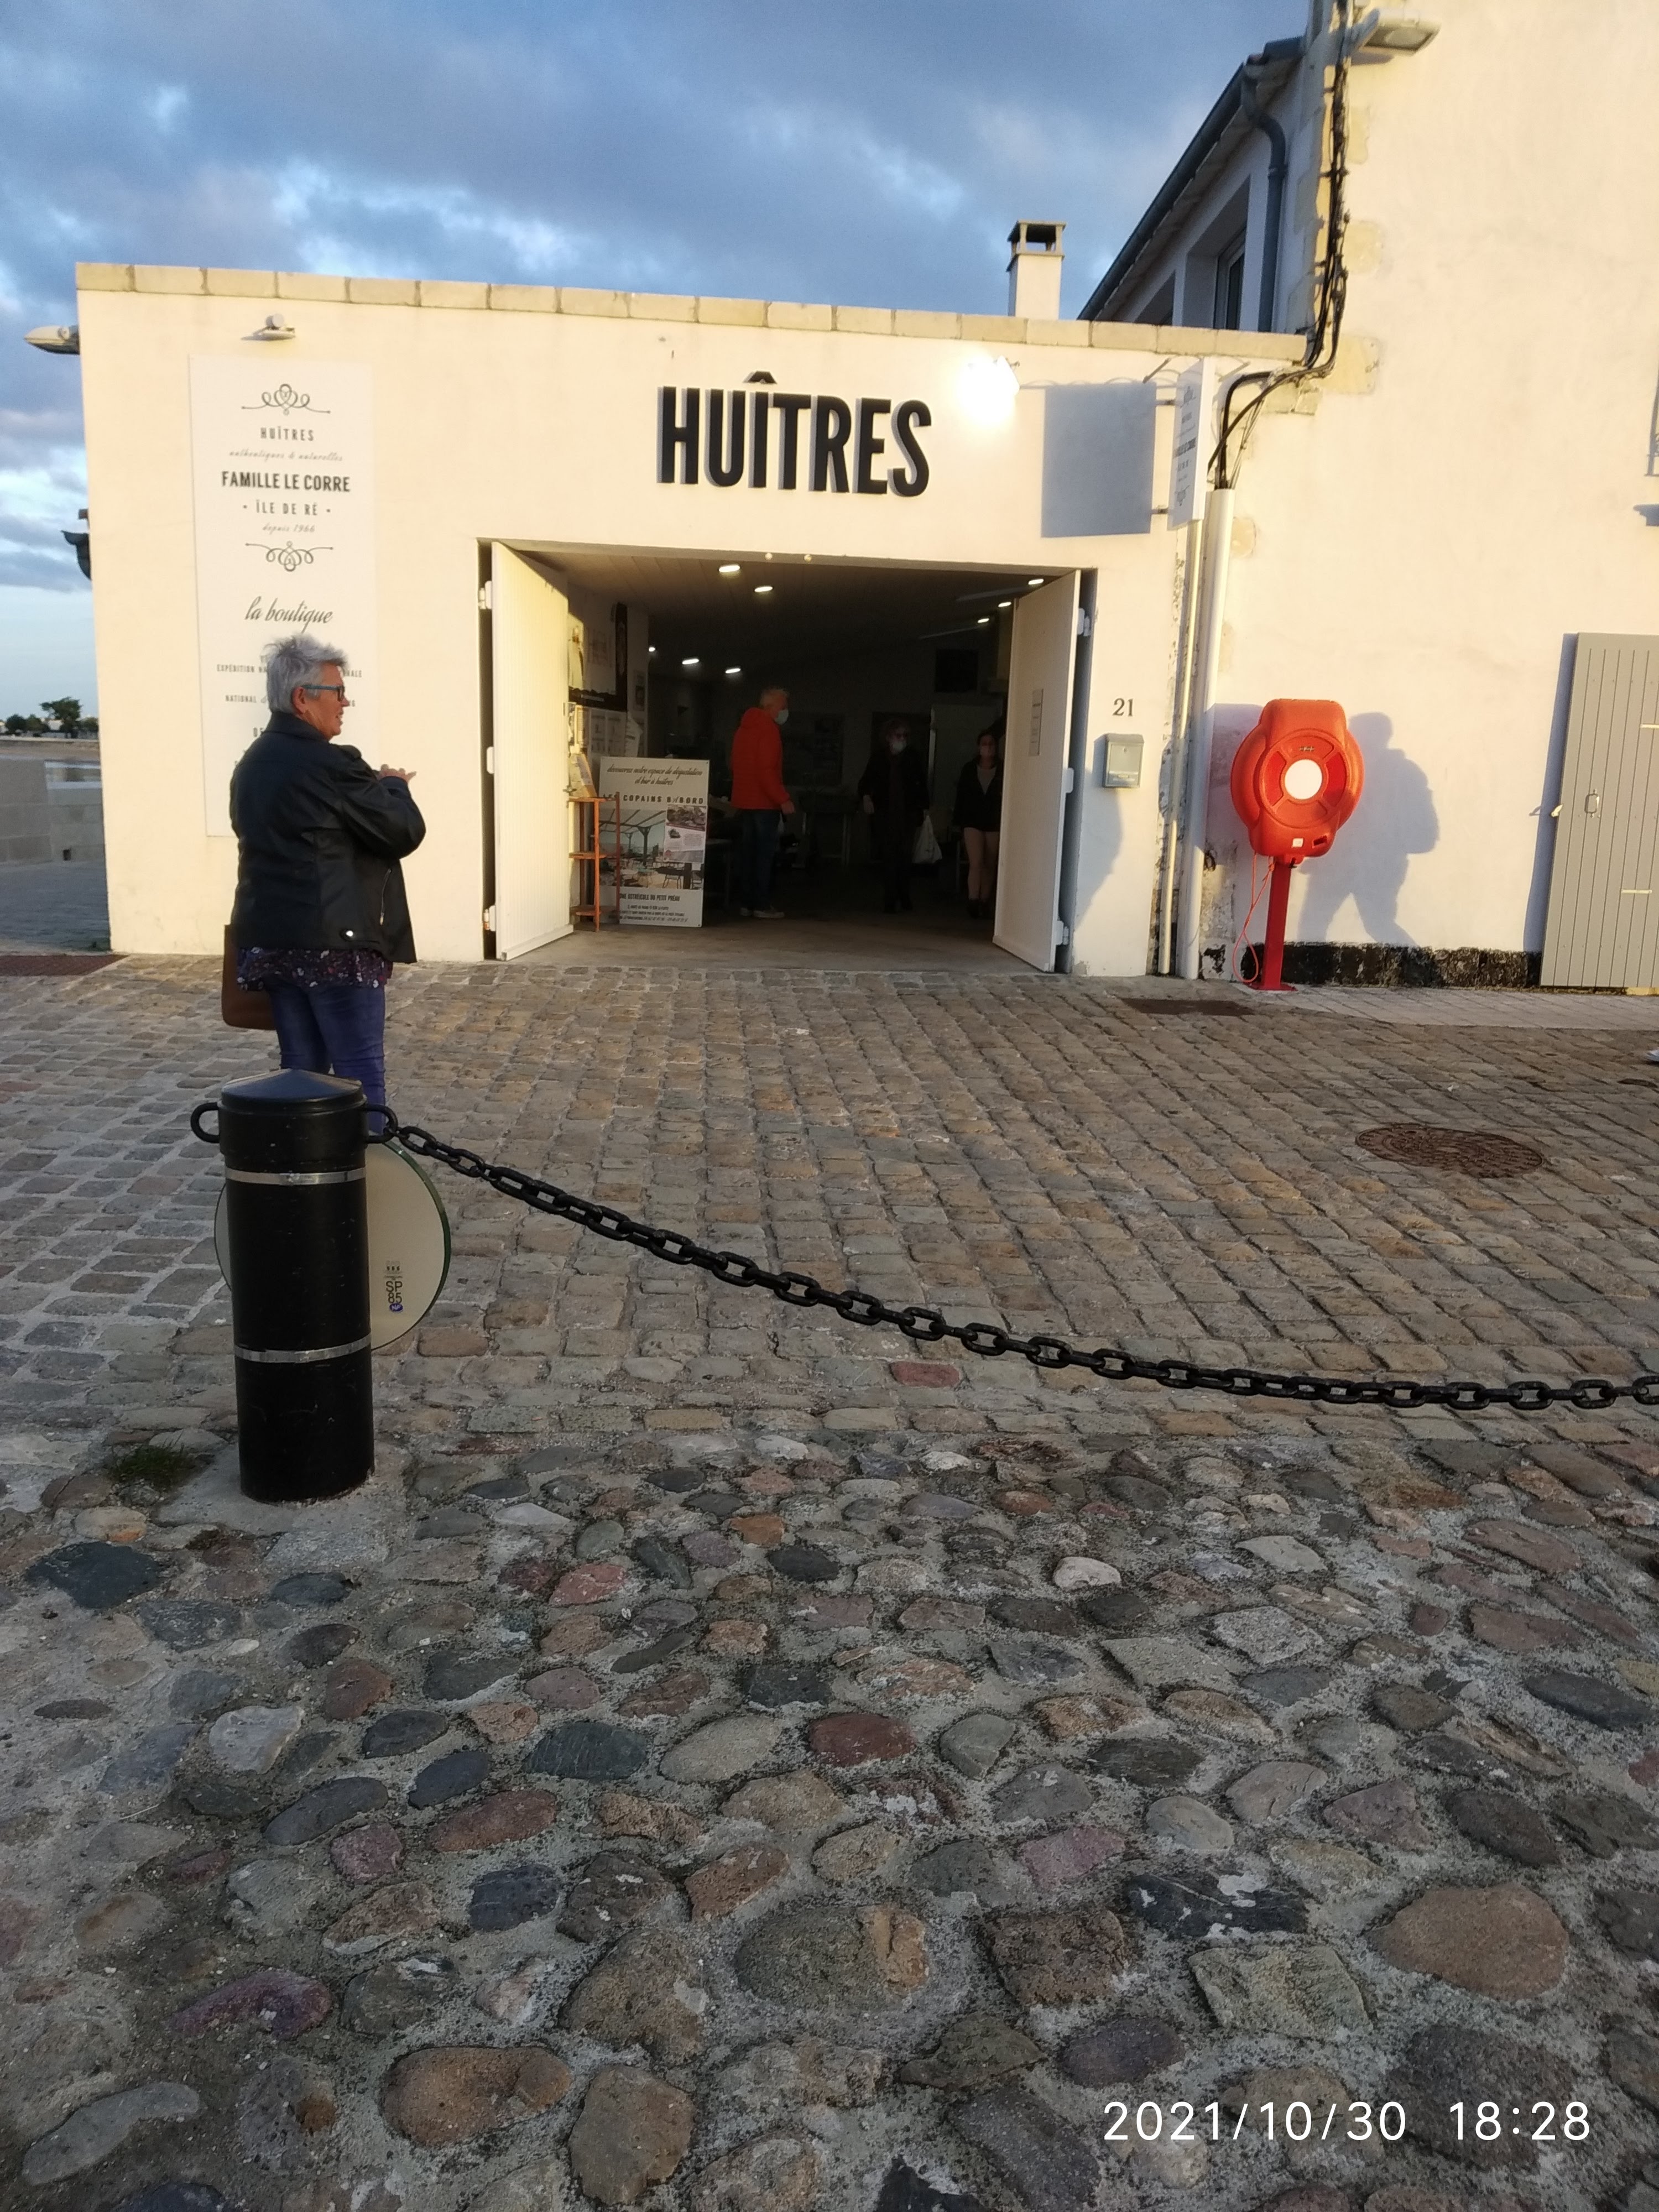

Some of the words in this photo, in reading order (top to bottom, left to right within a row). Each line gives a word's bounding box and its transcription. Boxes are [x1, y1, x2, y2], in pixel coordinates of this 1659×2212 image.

[260, 426, 314, 441] HUÎTRES
[657, 371, 931, 497] HUÎTRES
[222, 471, 280, 488] FAMILLE
[285, 474, 299, 489] LE
[304, 475, 350, 492] CORRE
[283, 503, 296, 515] DE
[305, 502, 317, 515] RÉ
[262, 523, 289, 535] depuis
[245, 596, 262, 620] la
[265, 597, 333, 633] boutique
[1113, 698, 1133, 717] 21
[386, 1281, 403, 1292] SP
[388, 1292, 403, 1303] 85
